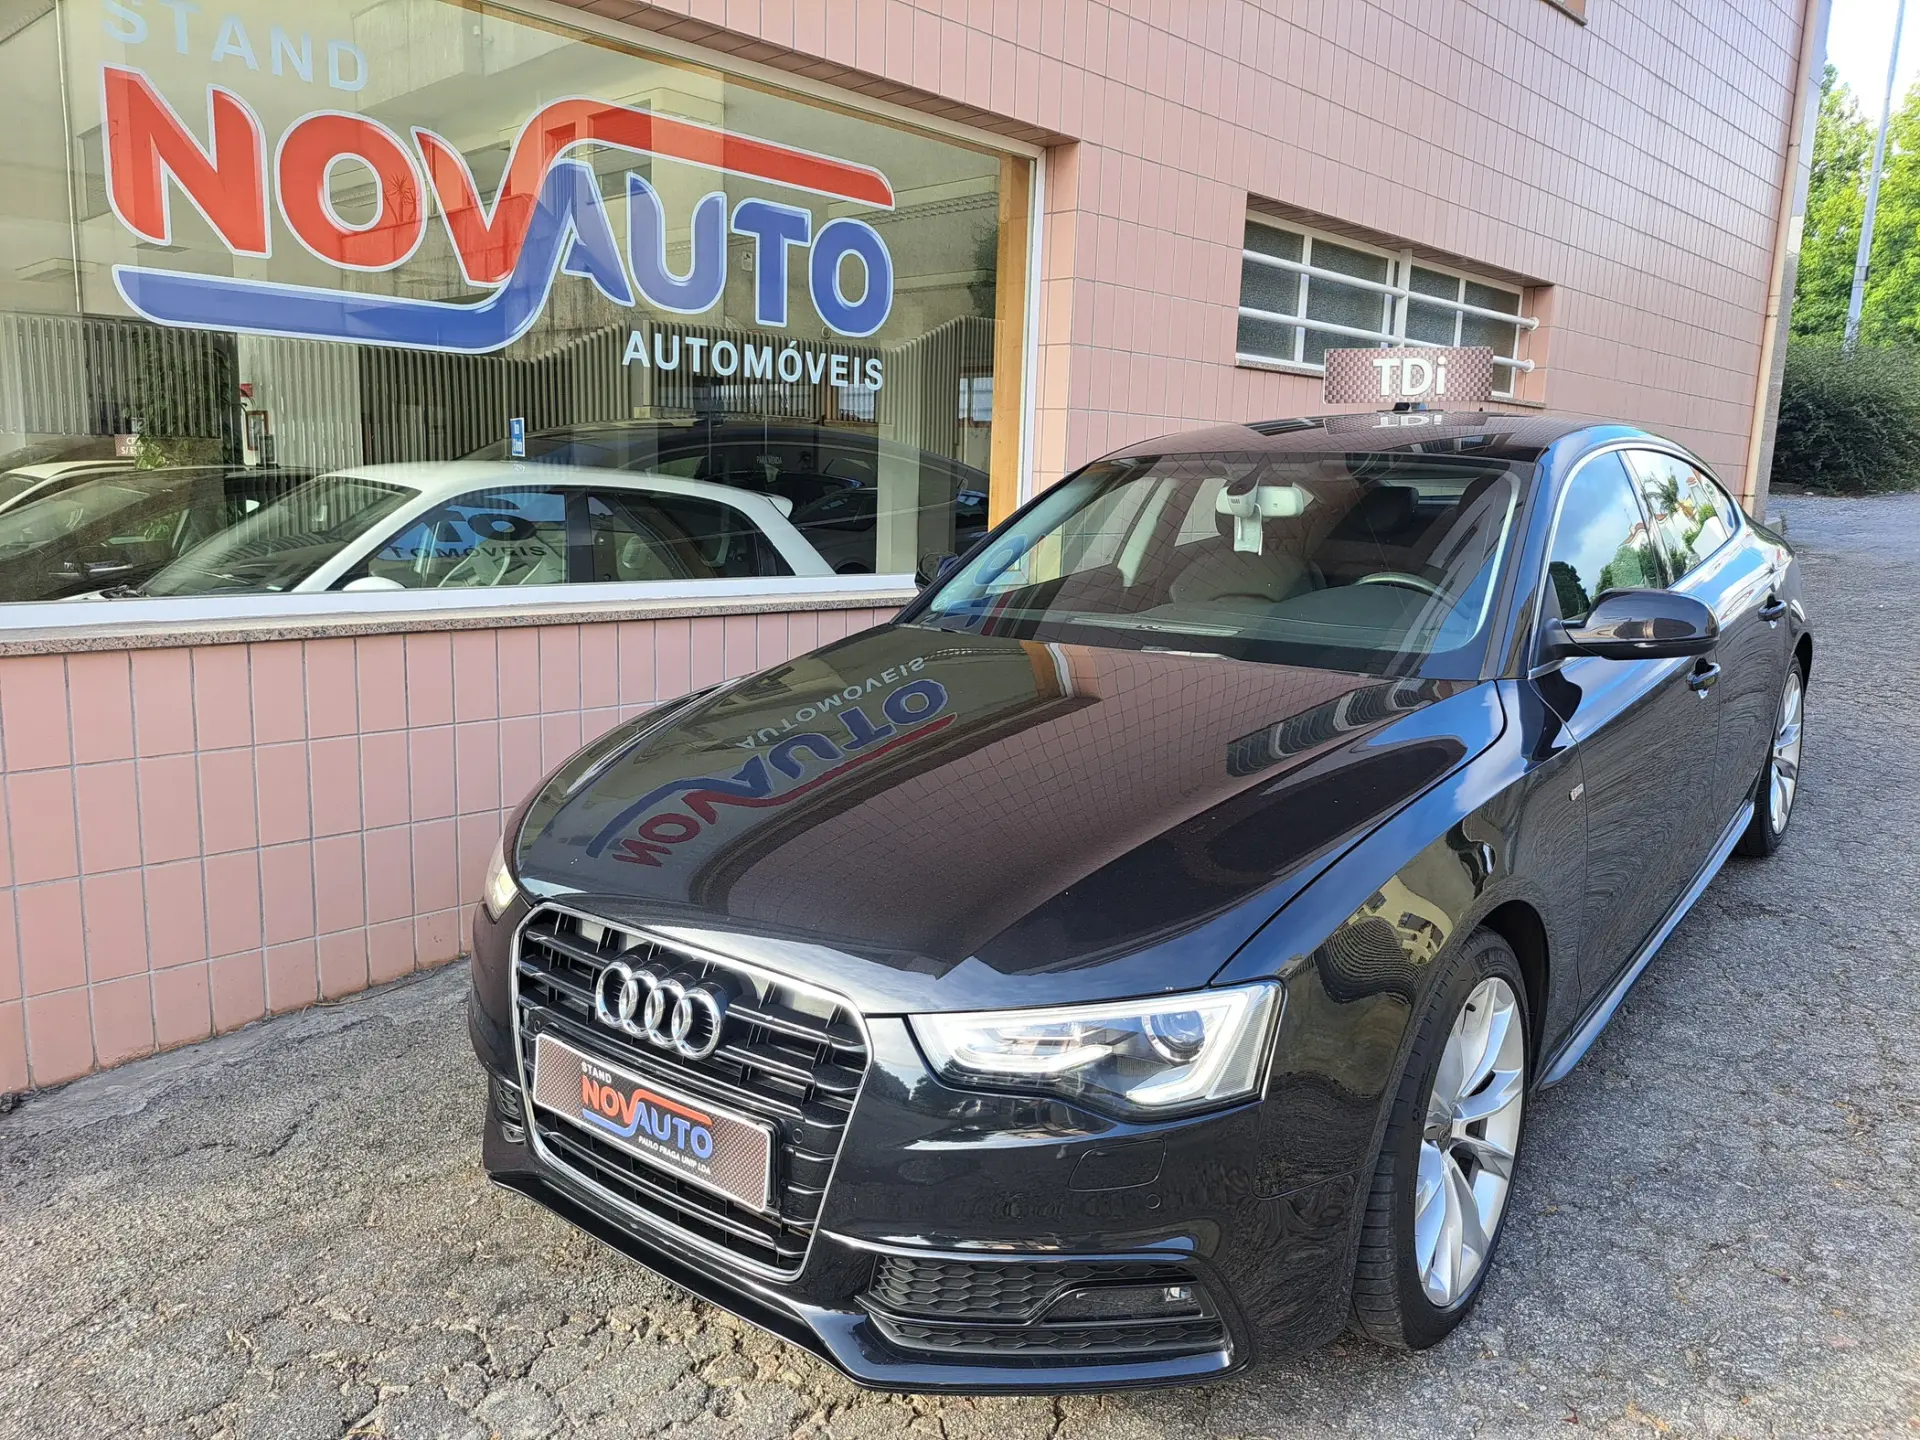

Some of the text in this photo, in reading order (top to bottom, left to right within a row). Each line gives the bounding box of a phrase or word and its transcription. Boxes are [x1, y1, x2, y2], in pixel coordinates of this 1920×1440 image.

[102, 0, 369, 91] STAND
[99, 63, 895, 352] NOVAUTO
[622, 330, 883, 391] AUTOMÓVEIS
[1372, 355, 1449, 396] TDi
[581, 1061, 612, 1084] STAND
[581, 1075, 714, 1159] NOVAUTO
[638, 1135, 659, 1151] PAULO
[659, 1144, 681, 1161] FRAGA
[697, 1162, 711, 1175] LDA
